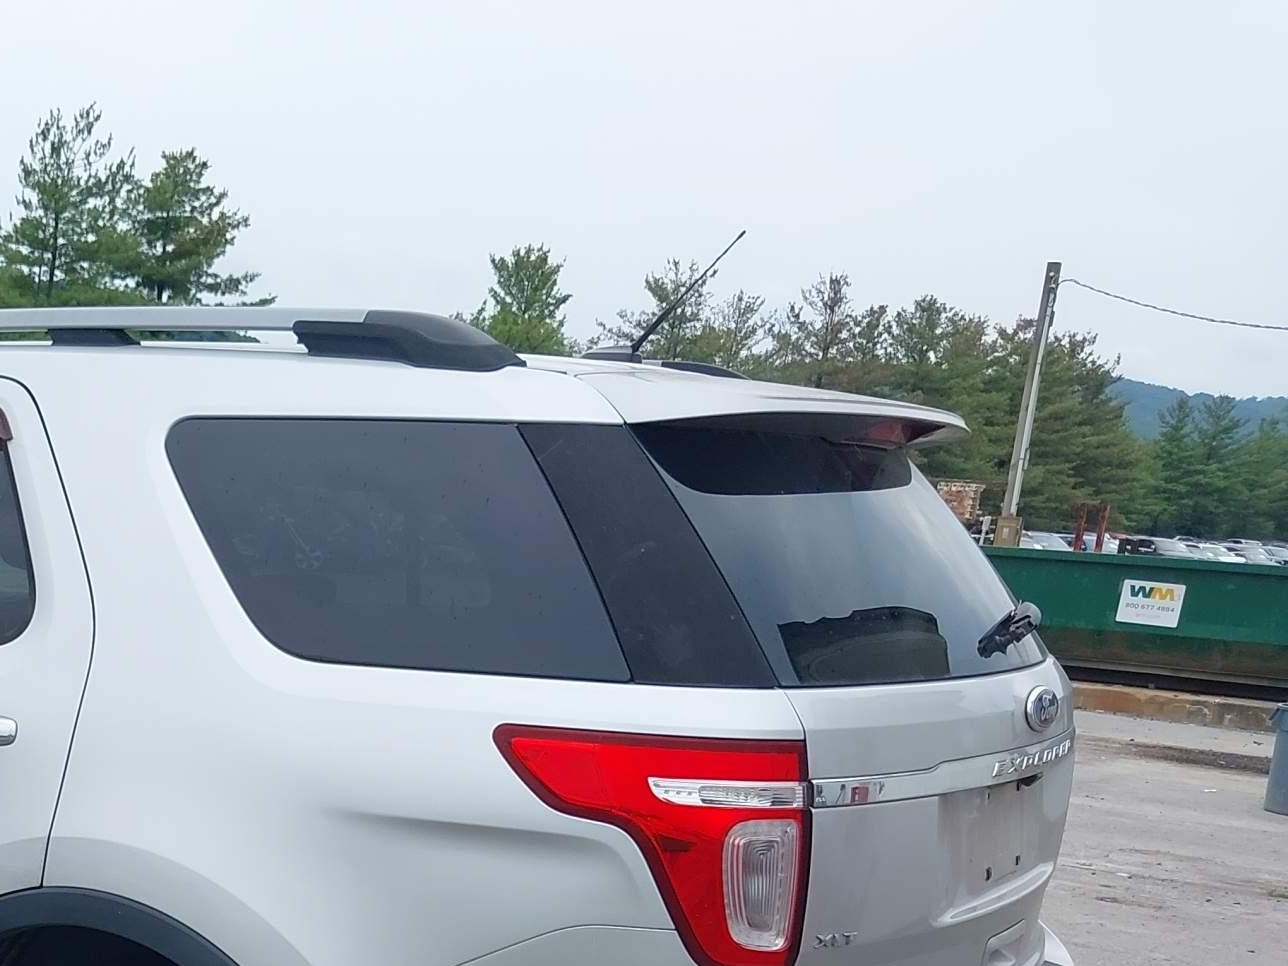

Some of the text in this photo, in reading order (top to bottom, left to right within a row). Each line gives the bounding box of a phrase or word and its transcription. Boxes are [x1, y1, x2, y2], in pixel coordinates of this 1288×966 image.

[1130, 584, 1176, 602] WM
[992, 739, 1072, 777] EXPLORER
[813, 931, 859, 950] XLT
